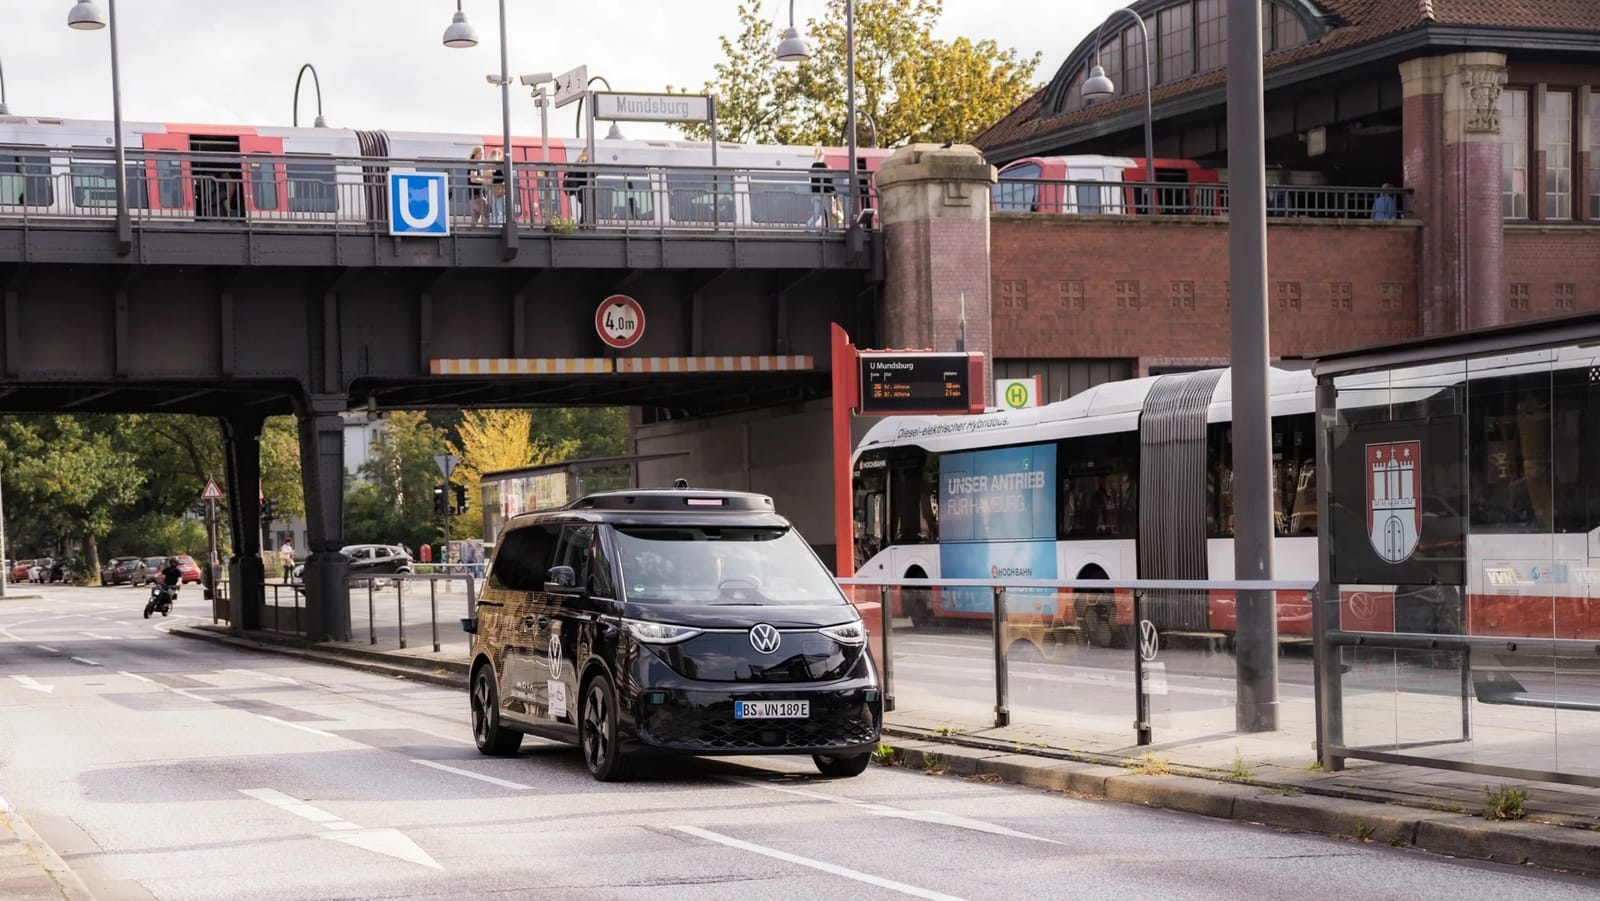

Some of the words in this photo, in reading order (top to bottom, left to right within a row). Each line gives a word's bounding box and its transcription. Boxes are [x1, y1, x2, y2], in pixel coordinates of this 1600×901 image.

[616, 95, 689, 118] Mundsburg
[399, 178, 438, 229] U
[876, 362, 914, 370] Mundsburg
[897, 422, 966, 438] Diesel-elektrischer
[948, 476, 988, 495] UNSER
[991, 472, 1045, 492] ANTRIEB
[948, 496, 969, 516] FÜR
[998, 568, 1032, 576] HOCHBAHN
[744, 704, 757, 716] BS
